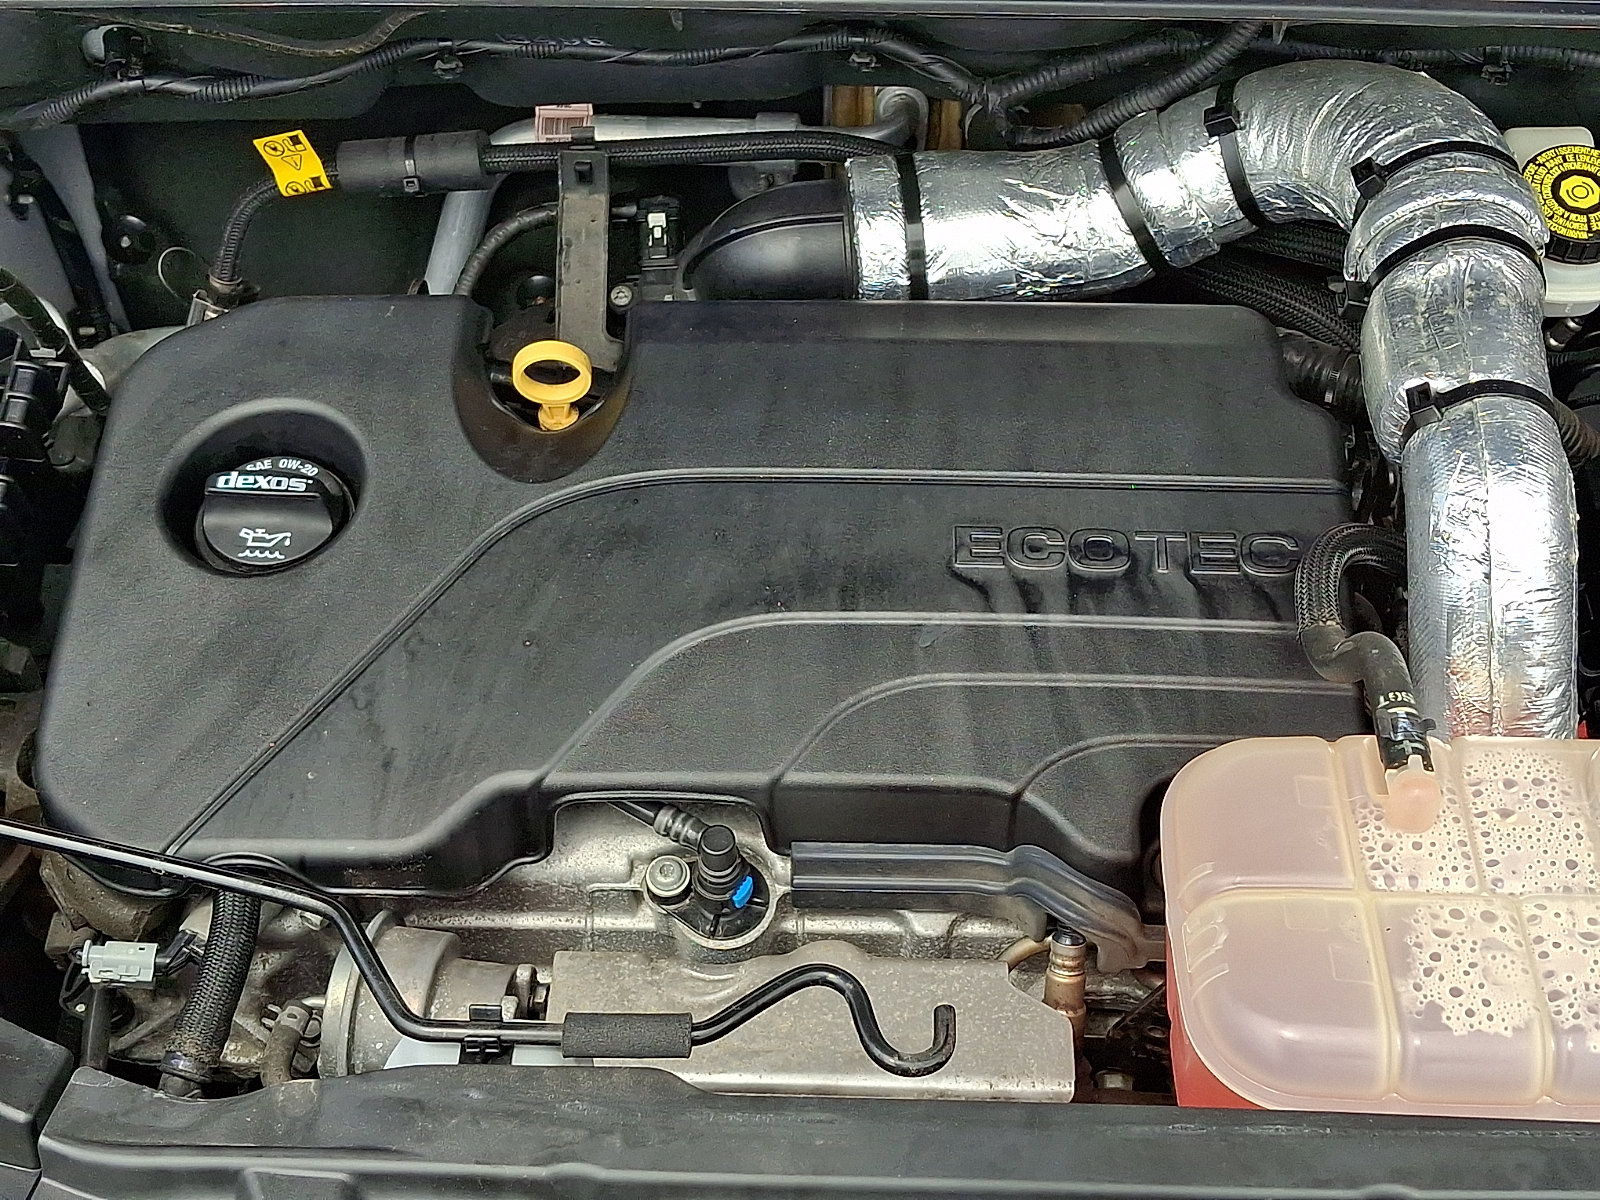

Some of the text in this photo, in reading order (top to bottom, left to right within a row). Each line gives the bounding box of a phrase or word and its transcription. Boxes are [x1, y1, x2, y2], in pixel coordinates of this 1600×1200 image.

[246, 459, 319, 476] SAE 0W-20
[216, 471, 308, 492] dexos
[953, 526, 1300, 576] ECOTEC
